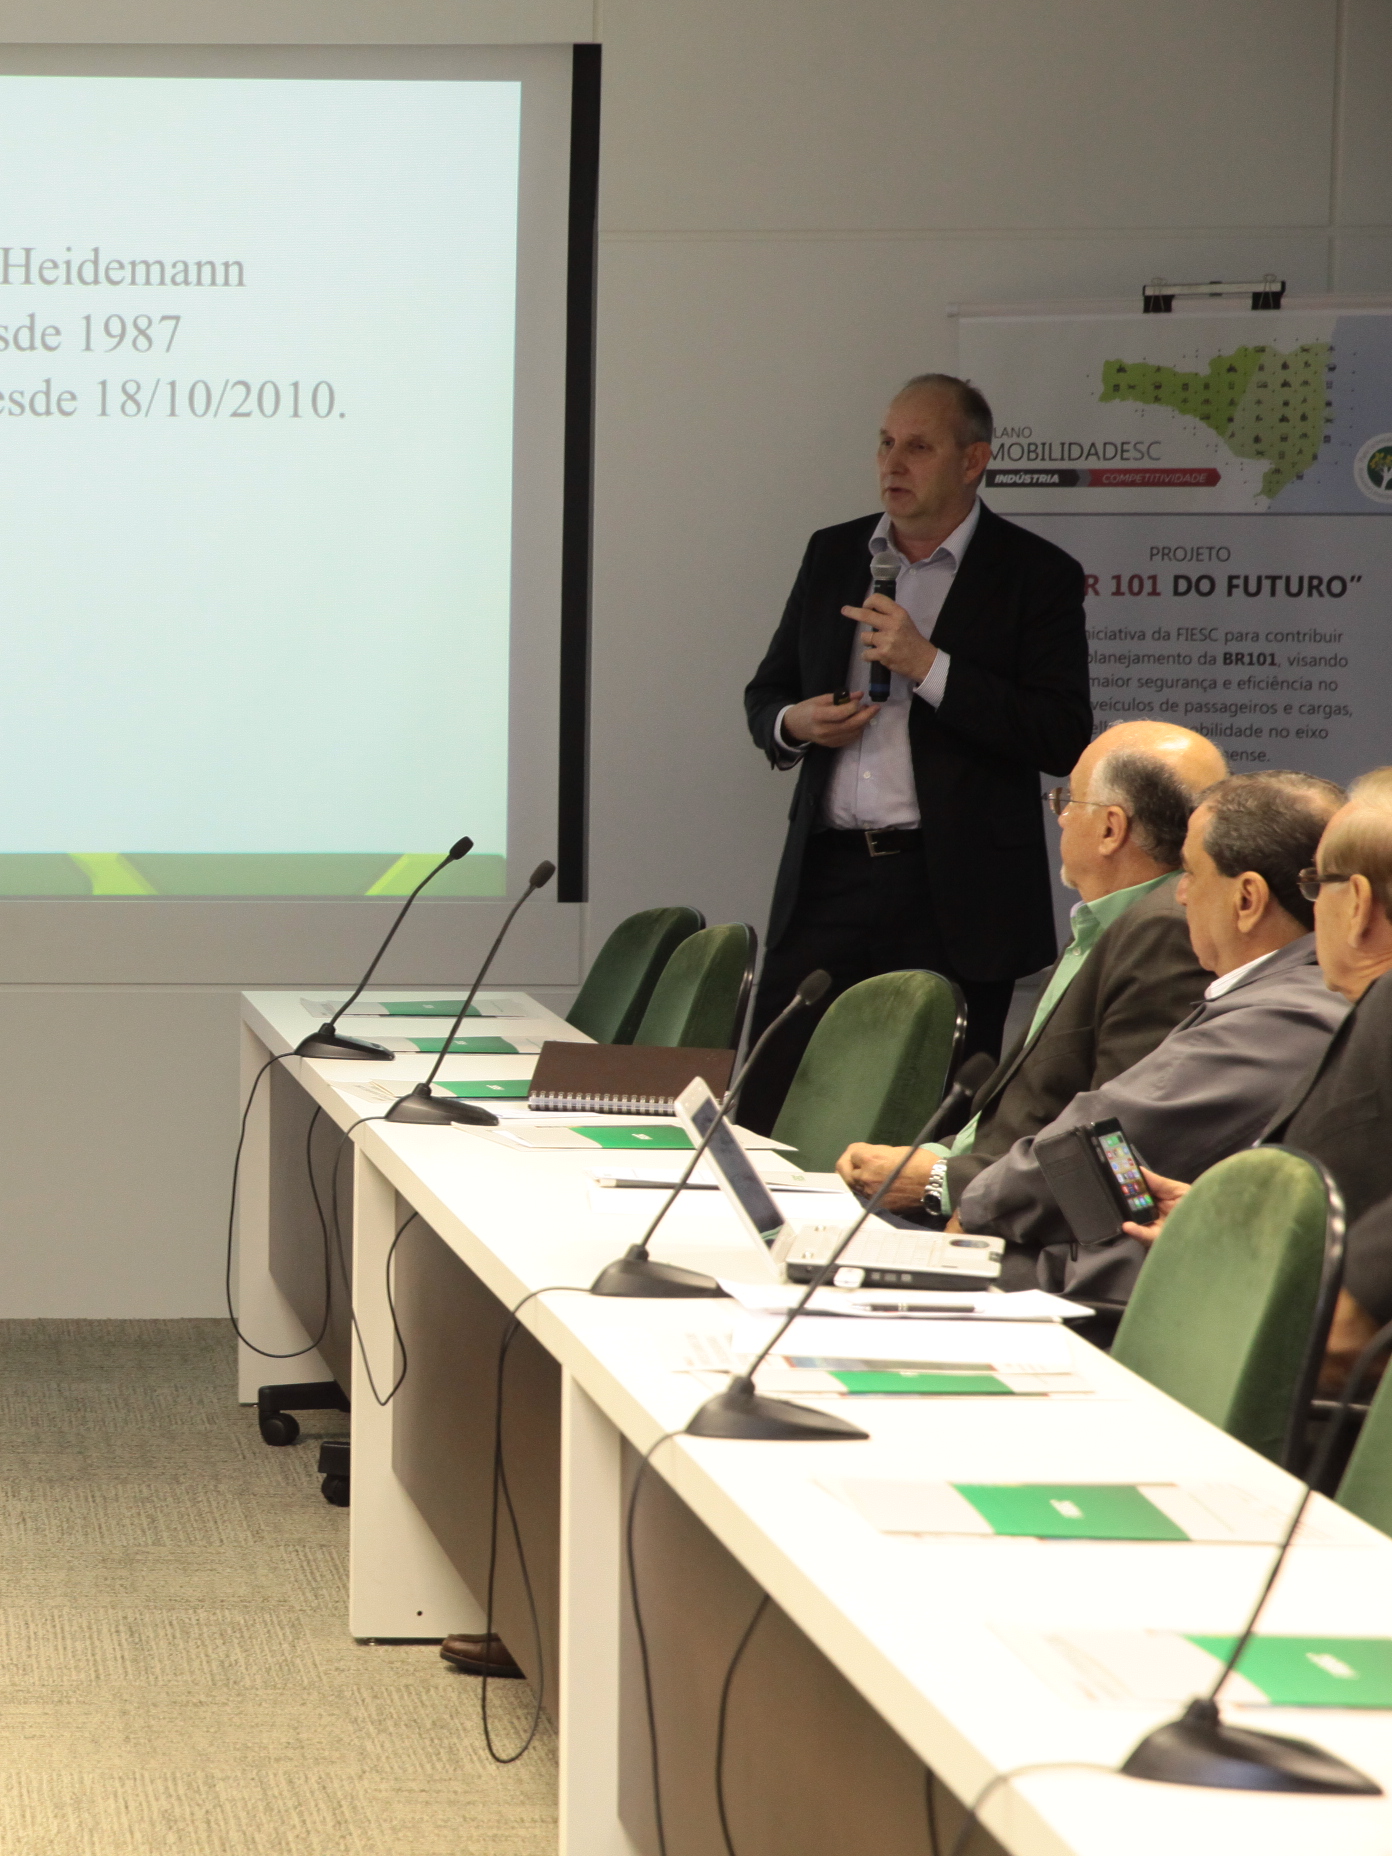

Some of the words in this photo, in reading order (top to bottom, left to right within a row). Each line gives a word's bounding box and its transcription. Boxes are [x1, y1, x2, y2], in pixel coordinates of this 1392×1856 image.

[0, 246, 246, 287] Heidemann
[82, 313, 182, 353] 1987
[98, 378, 346, 419] 18/10/2010.
[993, 426, 1032, 438] LANO
[994, 471, 1060, 484] INDÚSTRIA
[1102, 472, 1208, 484] COMPETITIVIDADE
[1149, 546, 1231, 562] PROJETO
[1110, 574, 1162, 597] 101
[1172, 574, 1216, 598] DO
[1084, 627, 1146, 641] niciativa
[1151, 627, 1171, 641] da
[1176, 628, 1219, 642] FIESC
[1224, 632, 1259, 645] para
[1265, 628, 1344, 643] contribuir
[1197, 652, 1217, 666] da
[1222, 652, 1281, 668] BR101,
[1287, 652, 1349, 668] visando
[1089, 674, 1131, 688] maior
[1137, 677, 1217, 693] segurança
[1222, 680, 1232, 690] e
[1237, 675, 1313, 691] eficiência
[1318, 681, 1339, 692] no
[1090, 697, 1155, 712] veículos
[1159, 698, 1179, 713] de
[1184, 699, 1278, 718] passageiros
[1283, 704, 1293, 715] e
[1298, 704, 1353, 718] cargas,
[1189, 722, 1263, 739] bilidade
[1268, 728, 1290, 740] no
[1295, 725, 1330, 741] eixo
